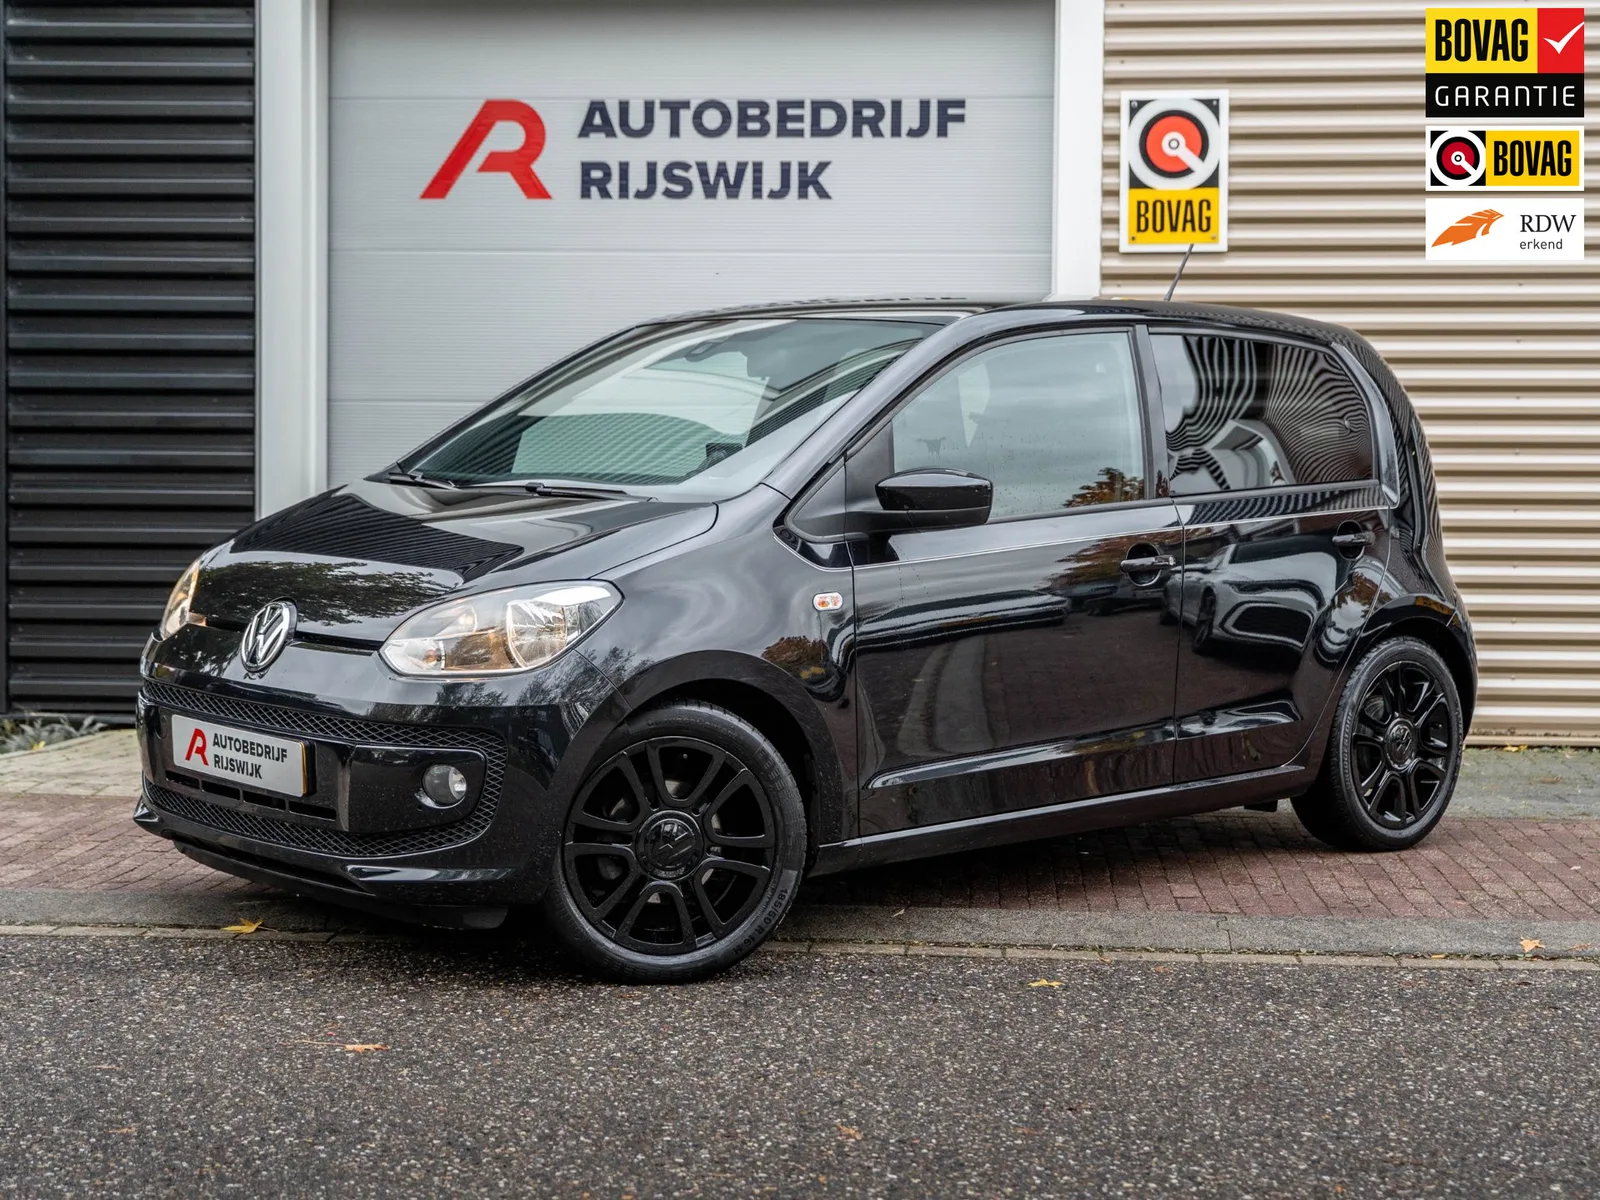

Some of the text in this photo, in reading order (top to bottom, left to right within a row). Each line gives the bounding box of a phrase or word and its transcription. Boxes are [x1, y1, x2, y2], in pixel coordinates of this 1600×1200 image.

[577, 98, 967, 139] AUTOBEDRIJF
[579, 160, 833, 200] RIJSWIJK
[1135, 198, 1212, 234] BOVAG
[212, 732, 288, 764] AUTOBEDRIJF
[213, 753, 263, 780] RIJSWIJK
[763, 888, 789, 926] 185/50
